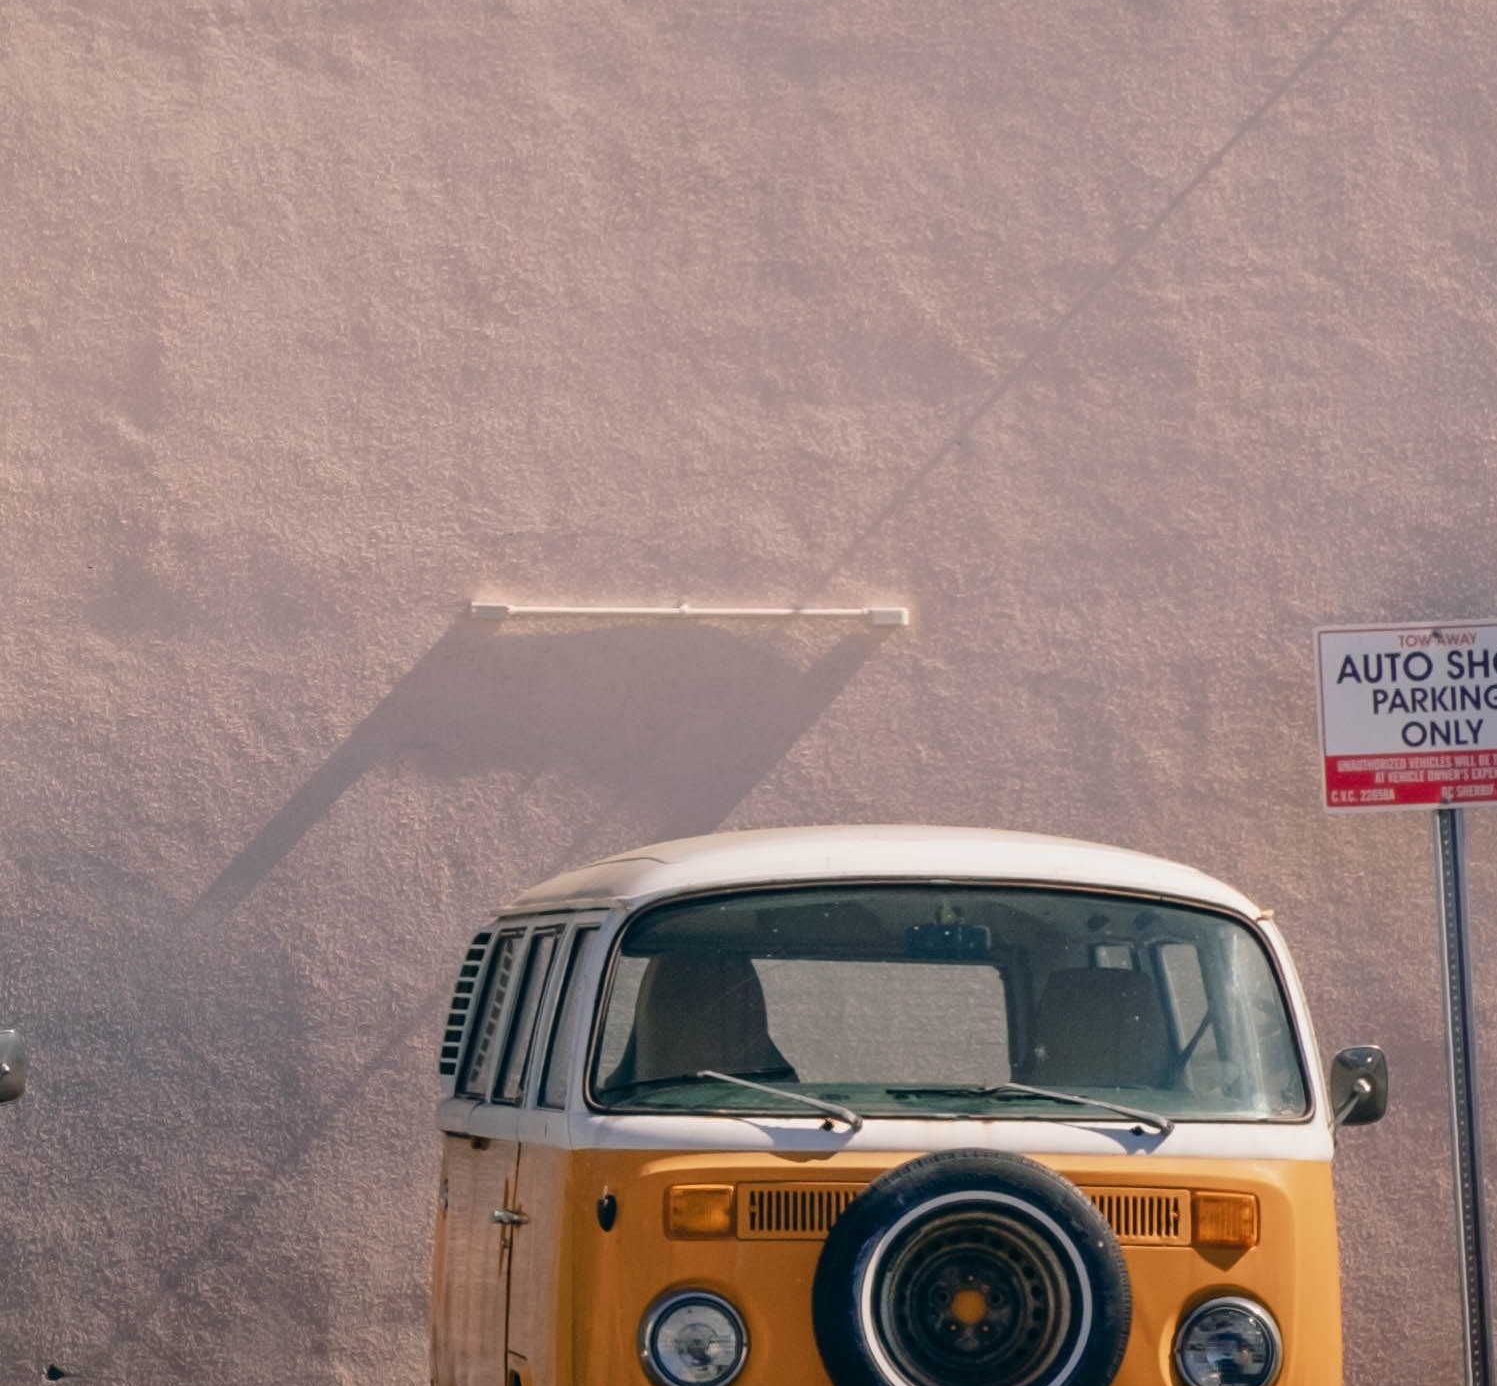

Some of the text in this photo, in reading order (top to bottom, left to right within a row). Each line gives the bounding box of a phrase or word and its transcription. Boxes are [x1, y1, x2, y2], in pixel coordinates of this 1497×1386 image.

[1398, 632, 1478, 648] TOW AWAY
[1336, 651, 1433, 684] AUTO
[1401, 719, 1484, 747] ONLY
